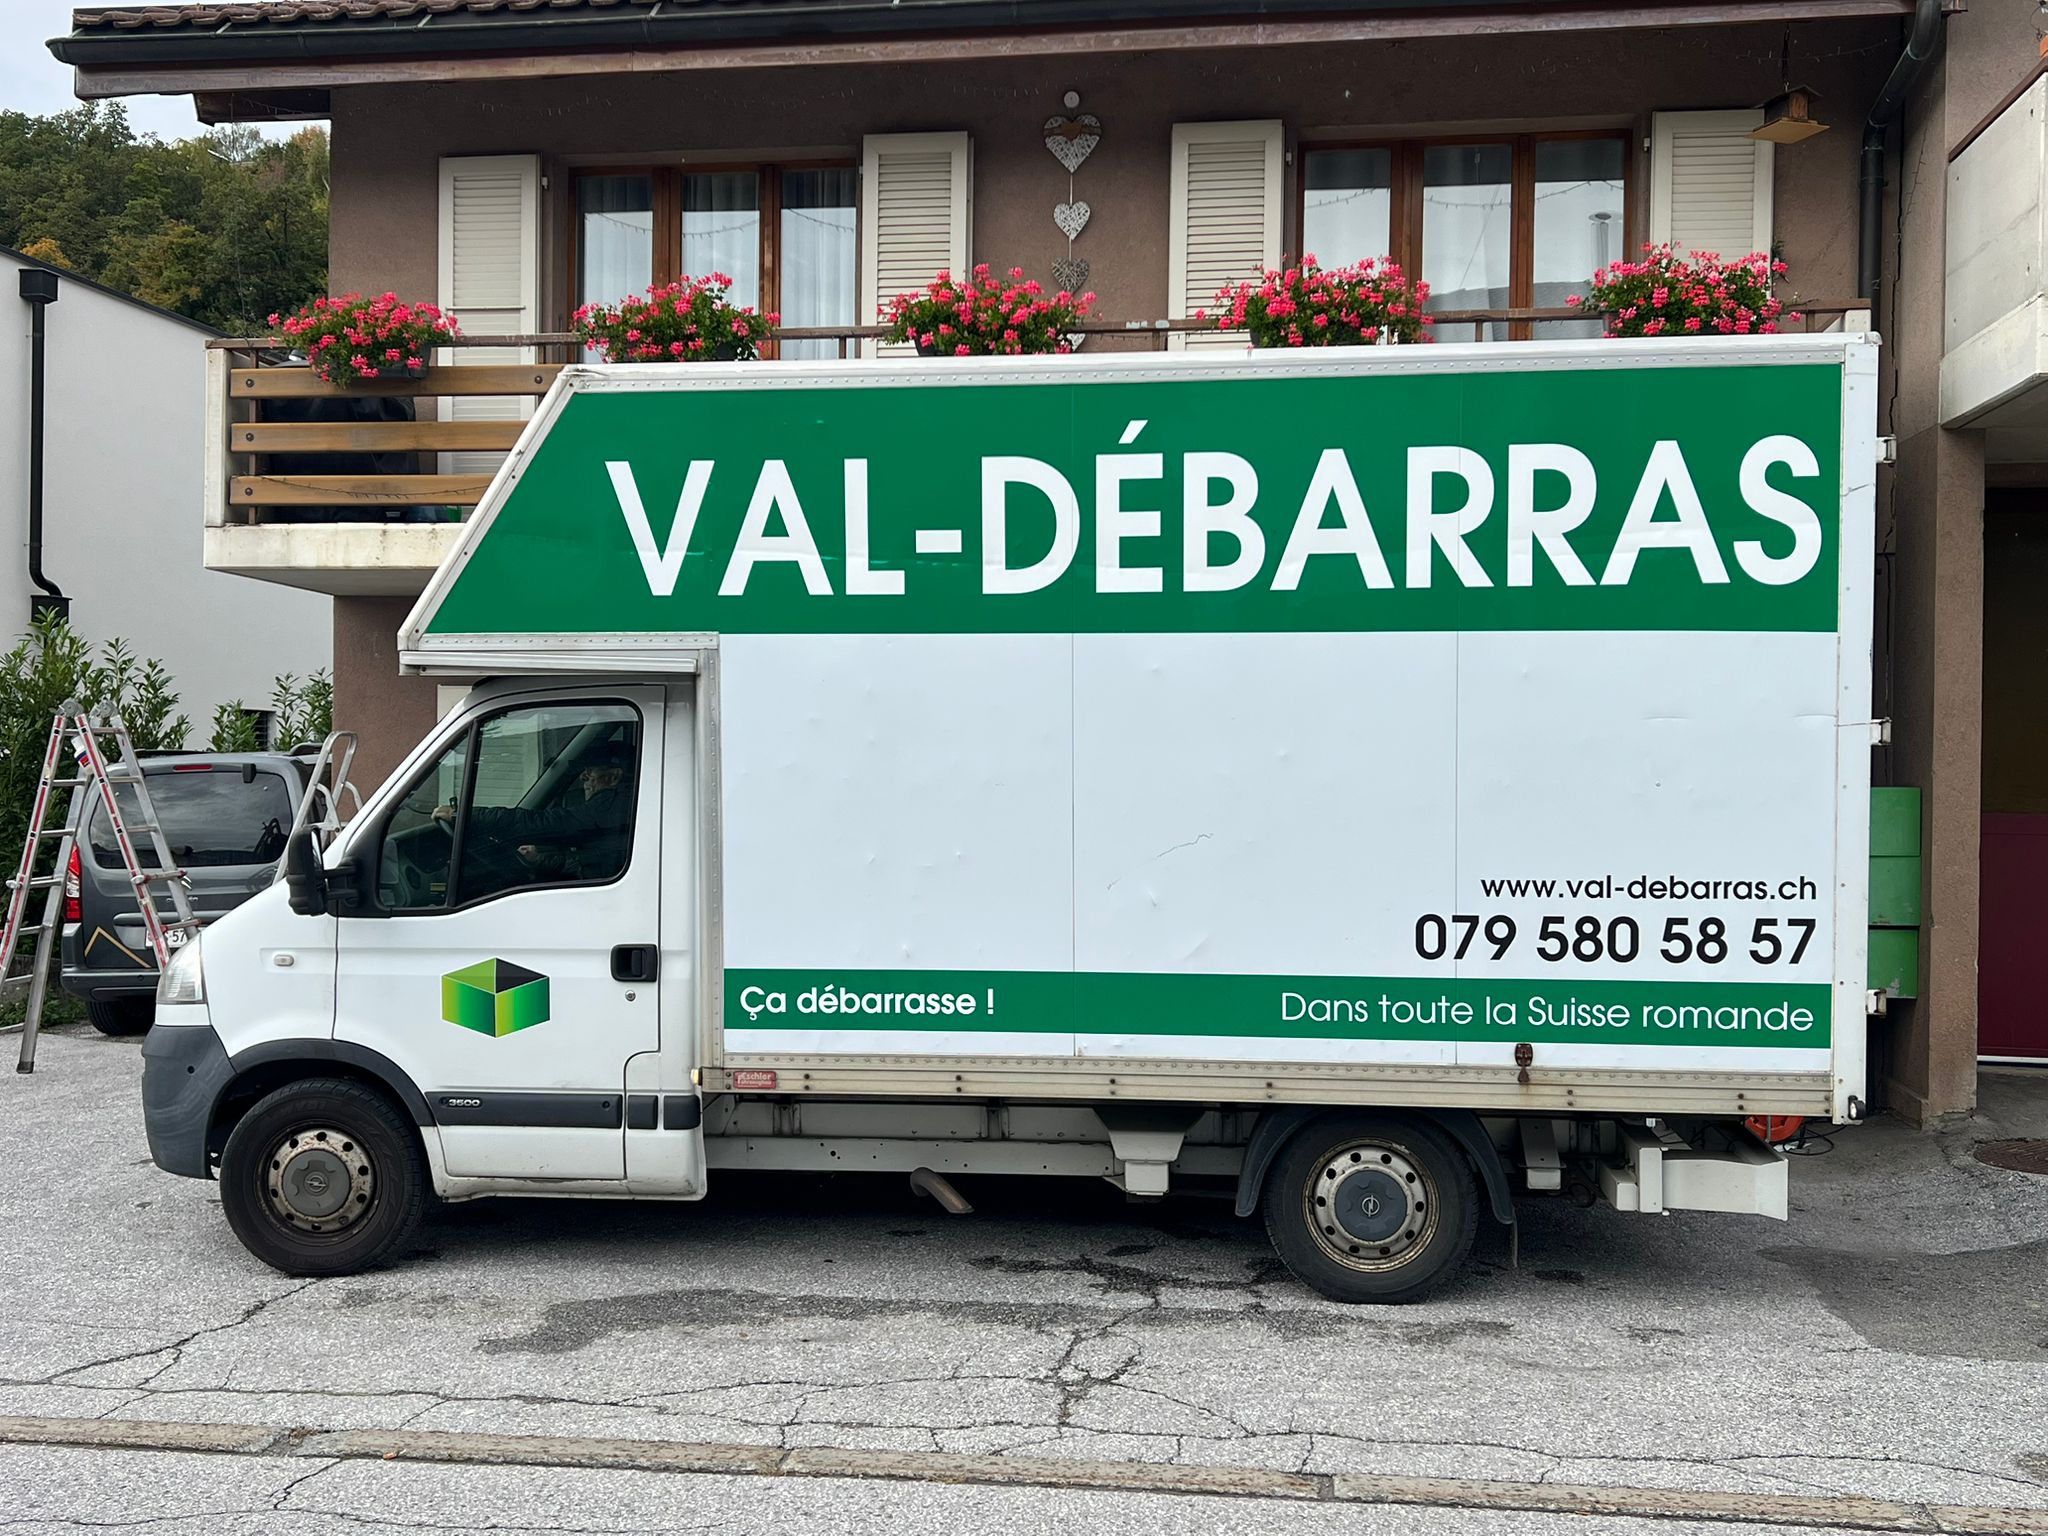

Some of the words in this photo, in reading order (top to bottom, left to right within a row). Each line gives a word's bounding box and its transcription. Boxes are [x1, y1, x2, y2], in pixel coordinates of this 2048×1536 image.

[604, 419, 1822, 596] VAL-DÉBARRAS
[1480, 874, 1817, 900] www.val-debarras.ch
[1415, 913, 1517, 961] 079
[1536, 915, 1640, 963] 580
[1660, 916, 1728, 964] 58
[1749, 918, 1816, 965] 57
[740, 986, 787, 1021] Ça
[796, 983, 977, 1015] débarrasse
[1281, 992, 1369, 1023] Dans
[1378, 994, 1474, 1025] toute
[1486, 996, 1517, 1025] la
[1527, 996, 1631, 1028] Suisse
[1642, 1001, 1814, 1031] romande
